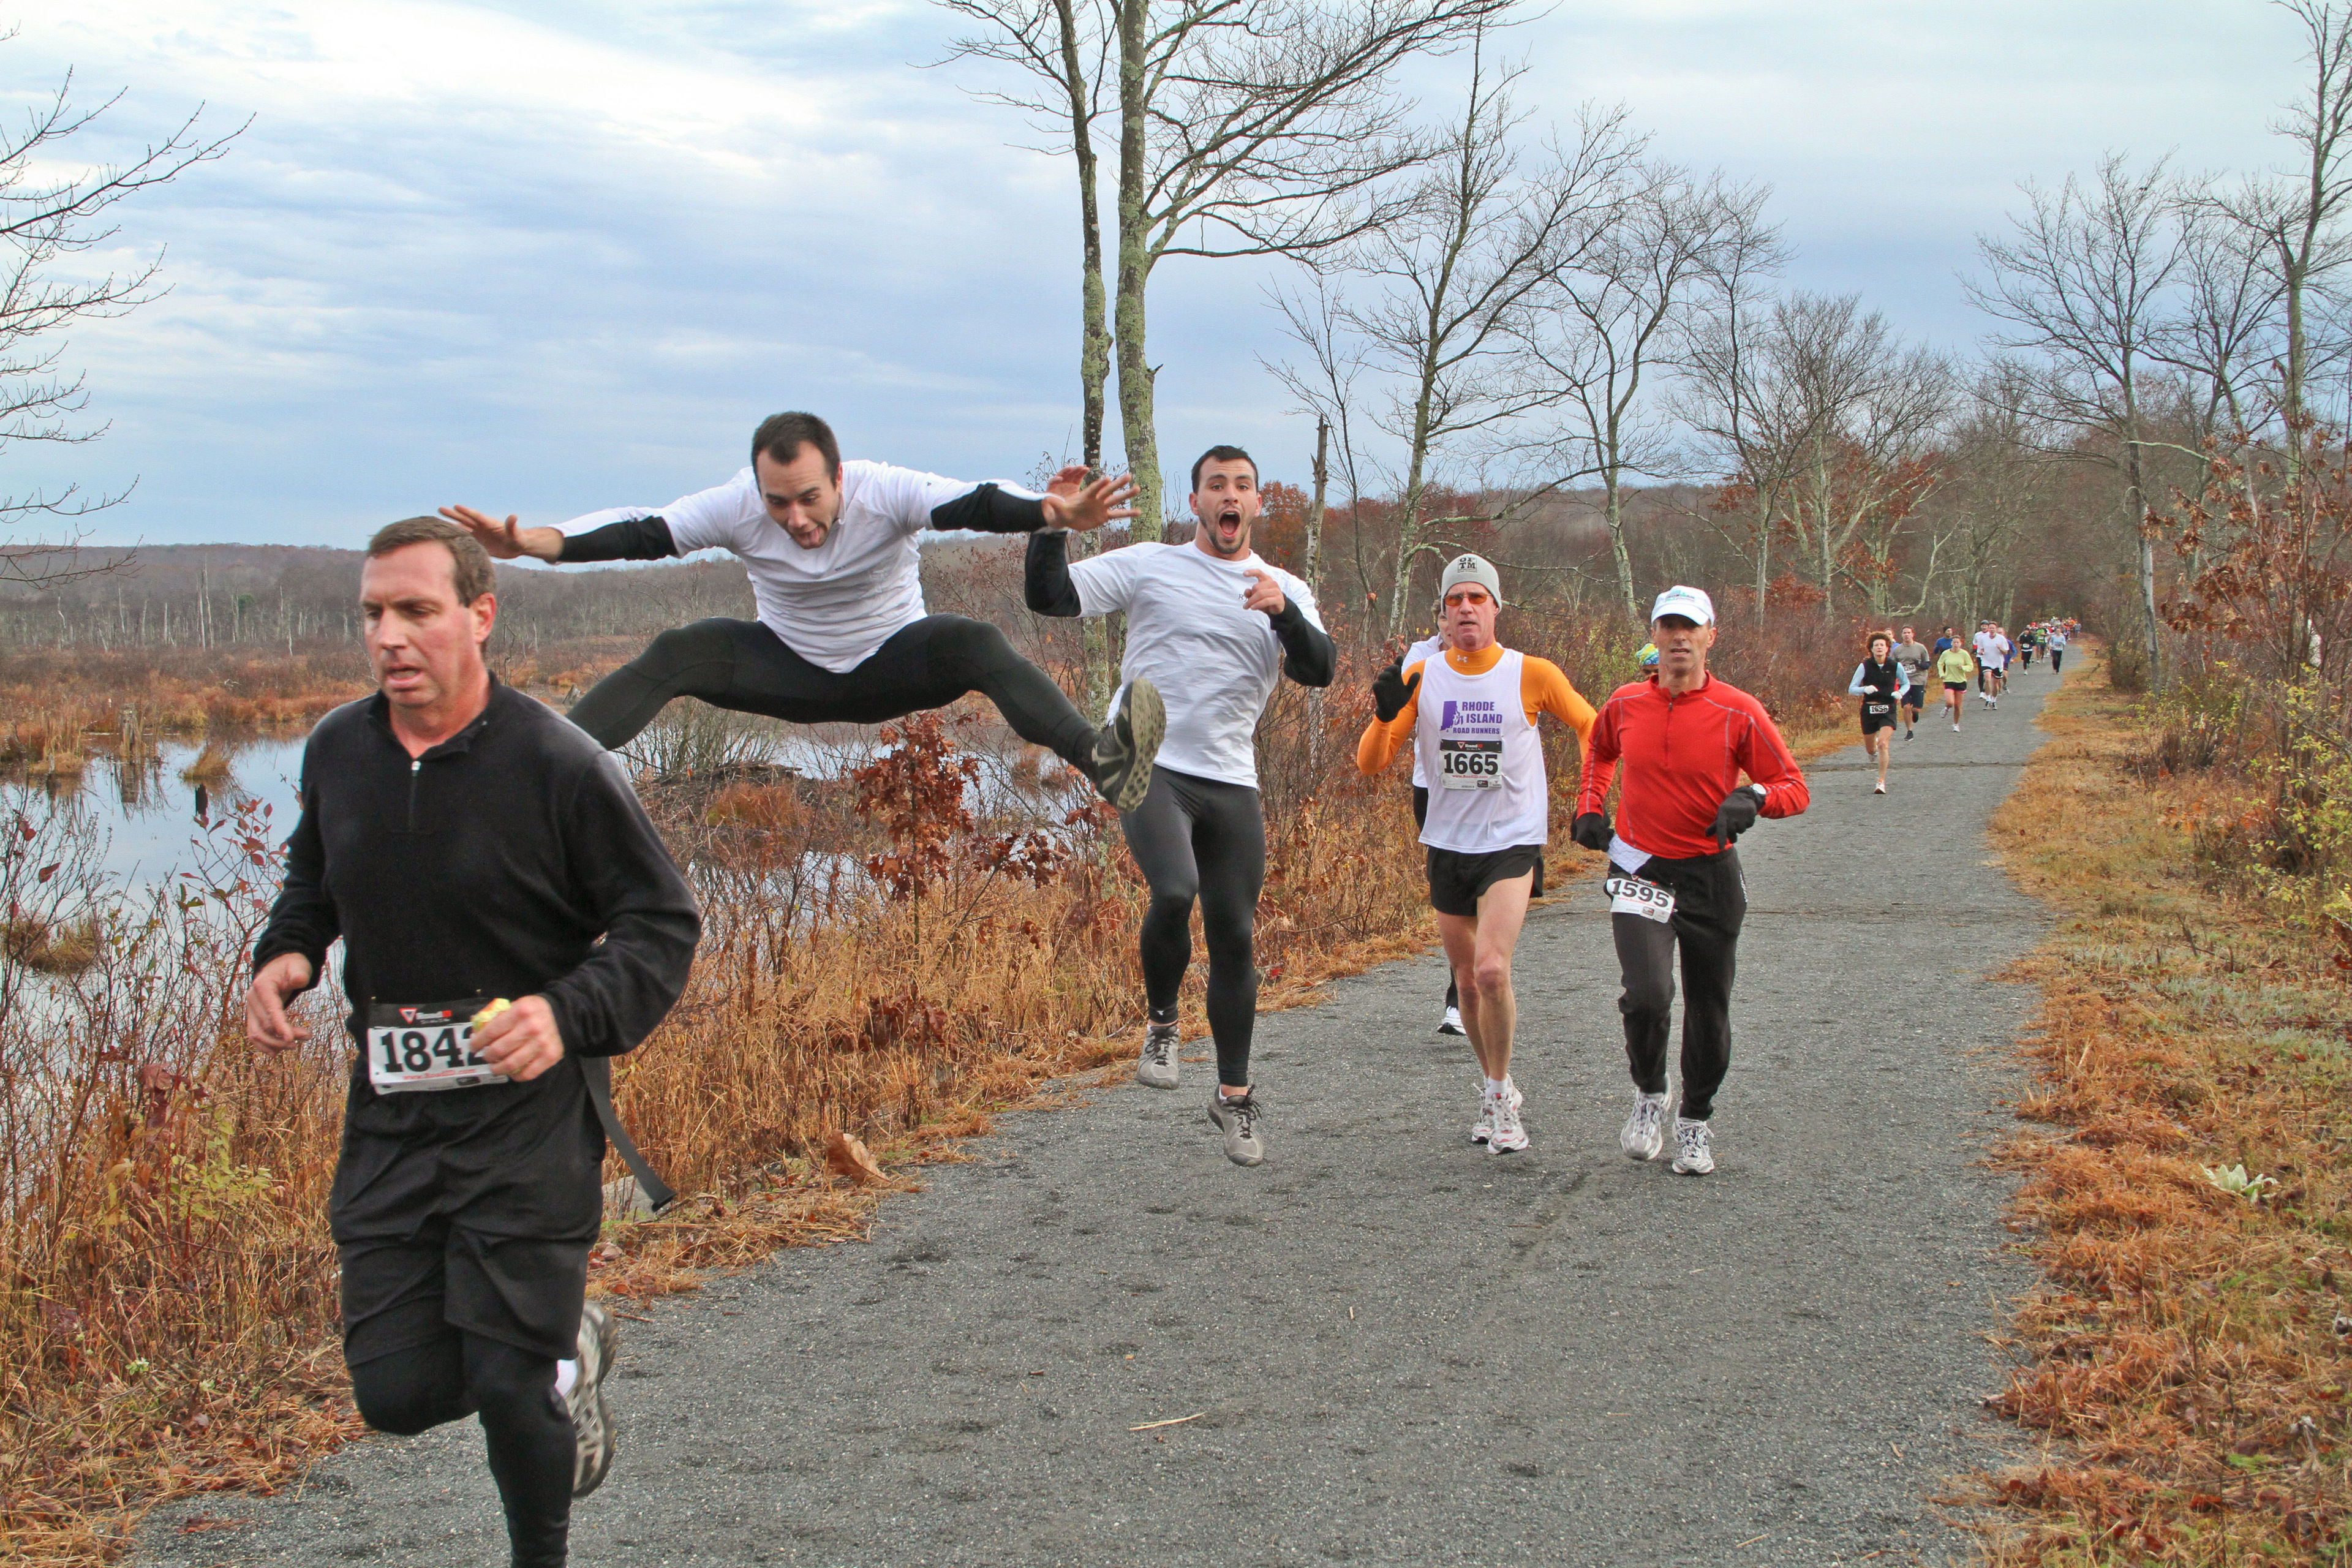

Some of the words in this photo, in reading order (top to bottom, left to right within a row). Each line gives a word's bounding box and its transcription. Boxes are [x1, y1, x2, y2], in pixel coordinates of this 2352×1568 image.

[1461, 701, 1494, 711] RHODE
[1466, 713, 1502, 723] ISLAND
[1444, 753, 1498, 775] 1665
[1611, 880, 1669, 908] 1595
